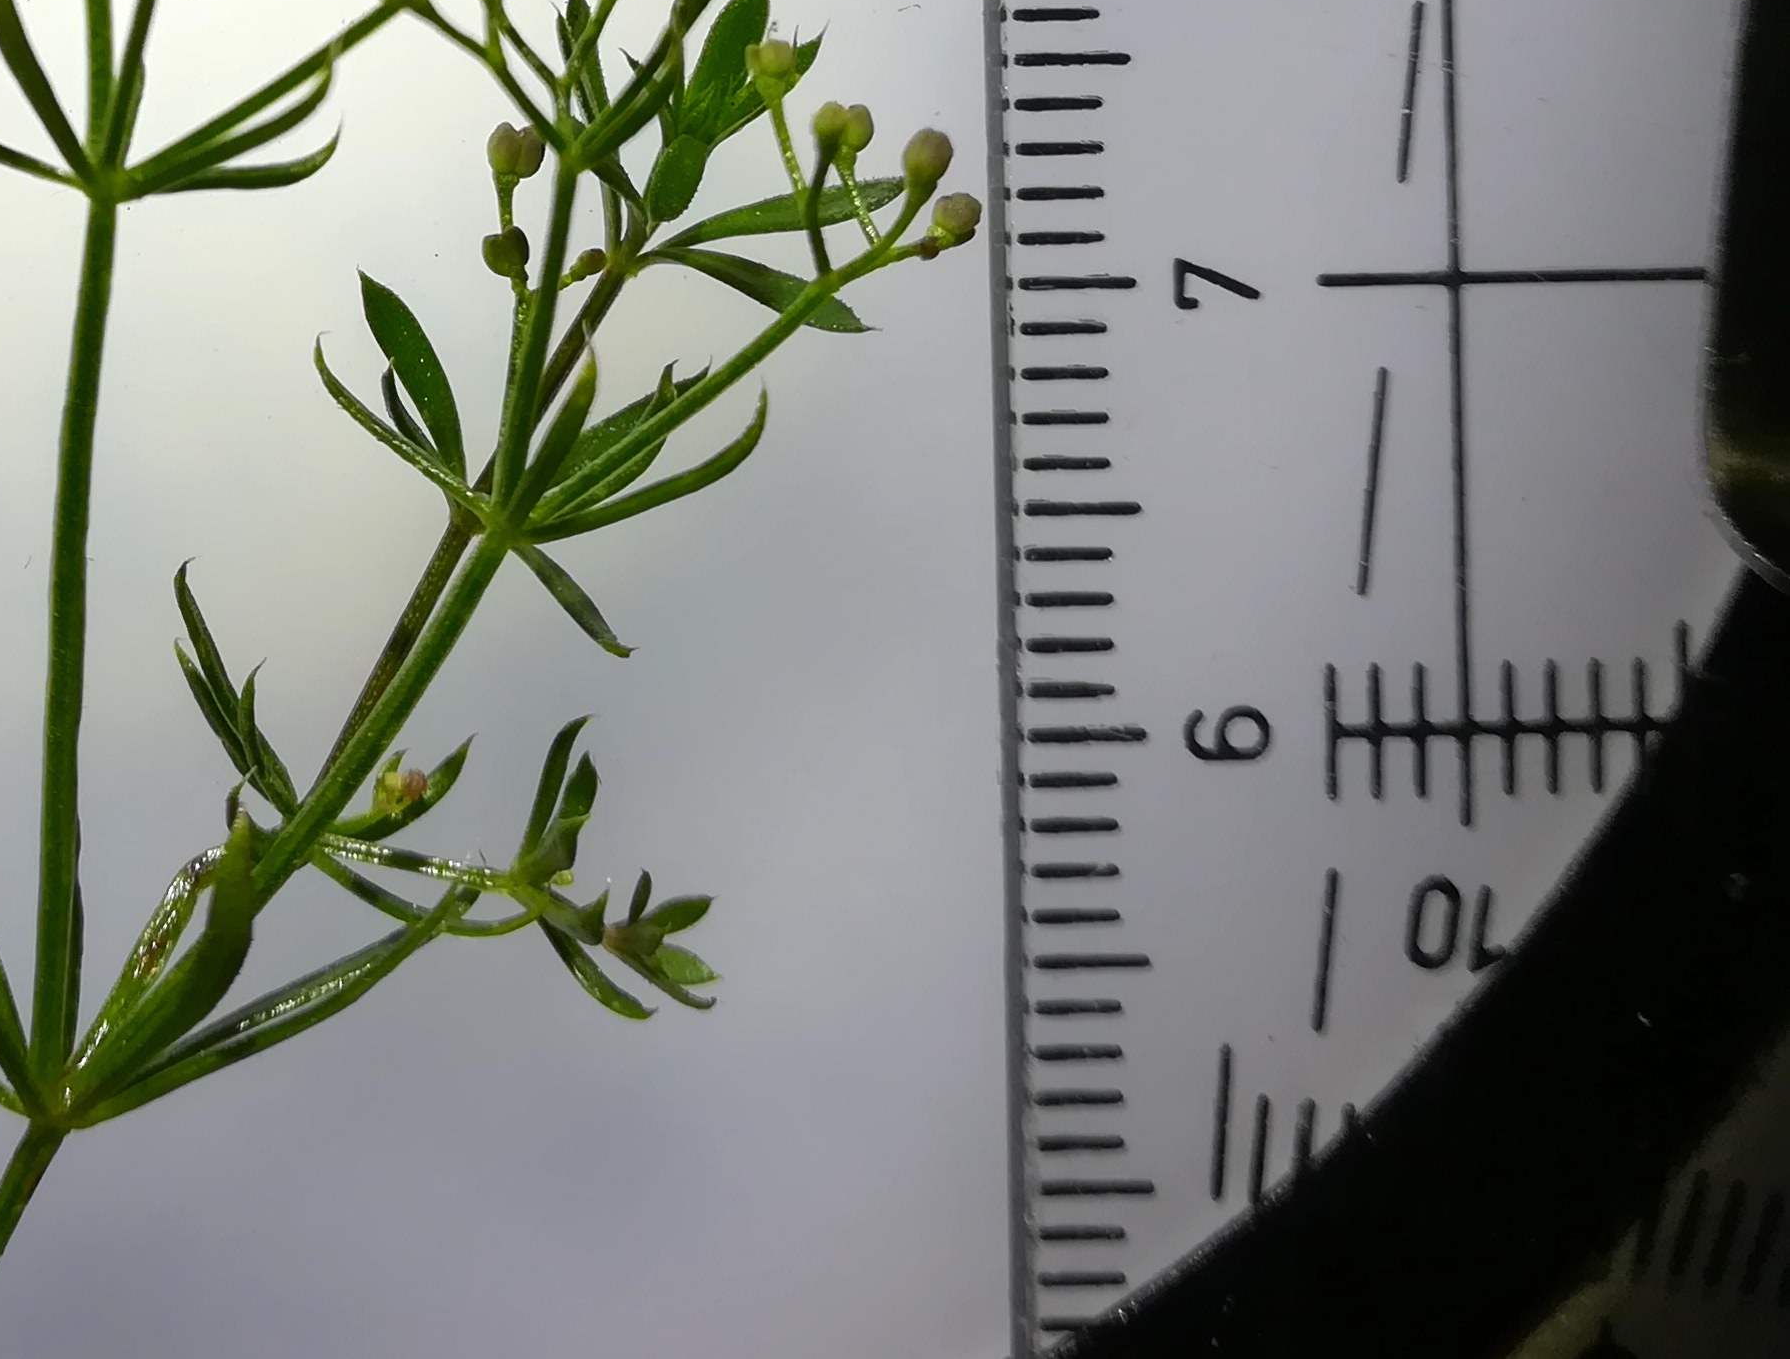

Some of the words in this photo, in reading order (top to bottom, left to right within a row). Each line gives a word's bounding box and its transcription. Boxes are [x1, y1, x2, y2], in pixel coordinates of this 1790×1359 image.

[1172, 256, 1262, 312] 7
[1182, 704, 1273, 763] 6
[1405, 874, 1507, 972] 10
